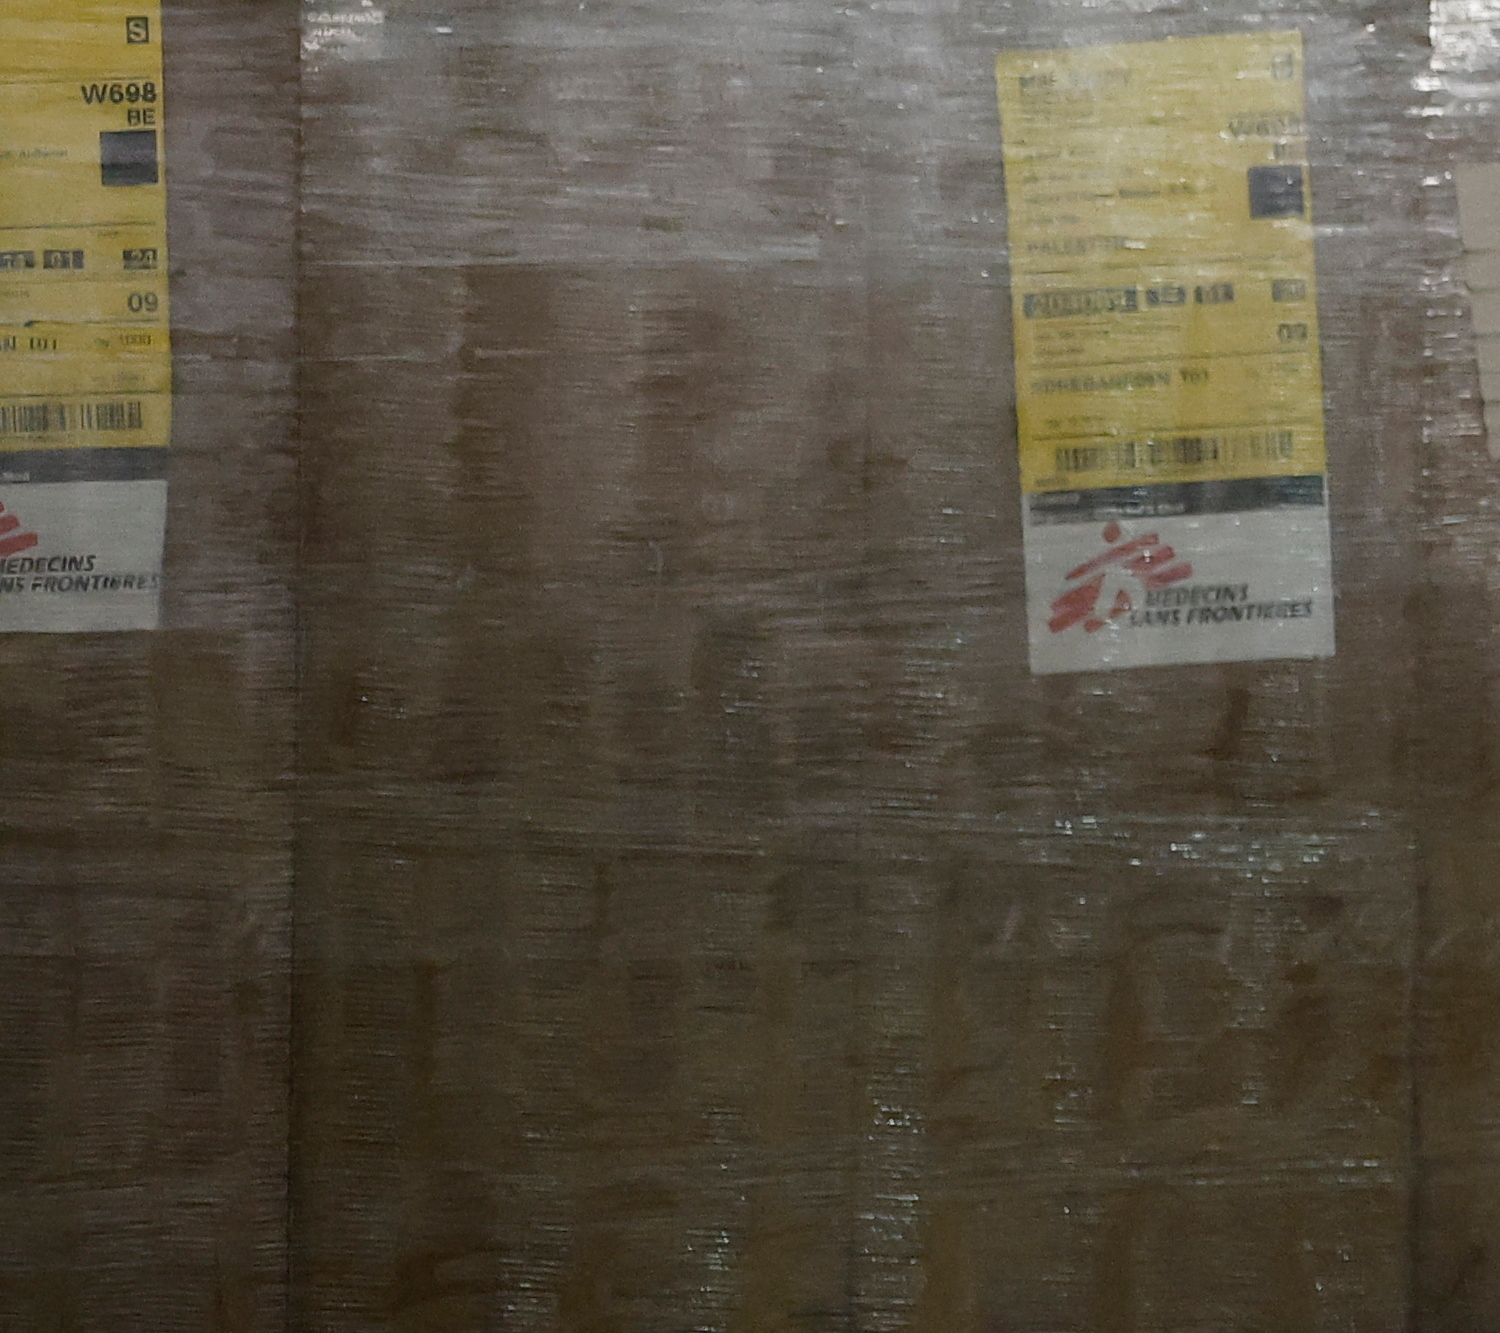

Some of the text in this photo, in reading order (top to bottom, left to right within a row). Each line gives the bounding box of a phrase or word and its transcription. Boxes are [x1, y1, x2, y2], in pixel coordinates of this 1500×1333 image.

[127, 17, 148, 43] S
[81, 82, 157, 105] W698
[127, 292, 158, 313] 09
